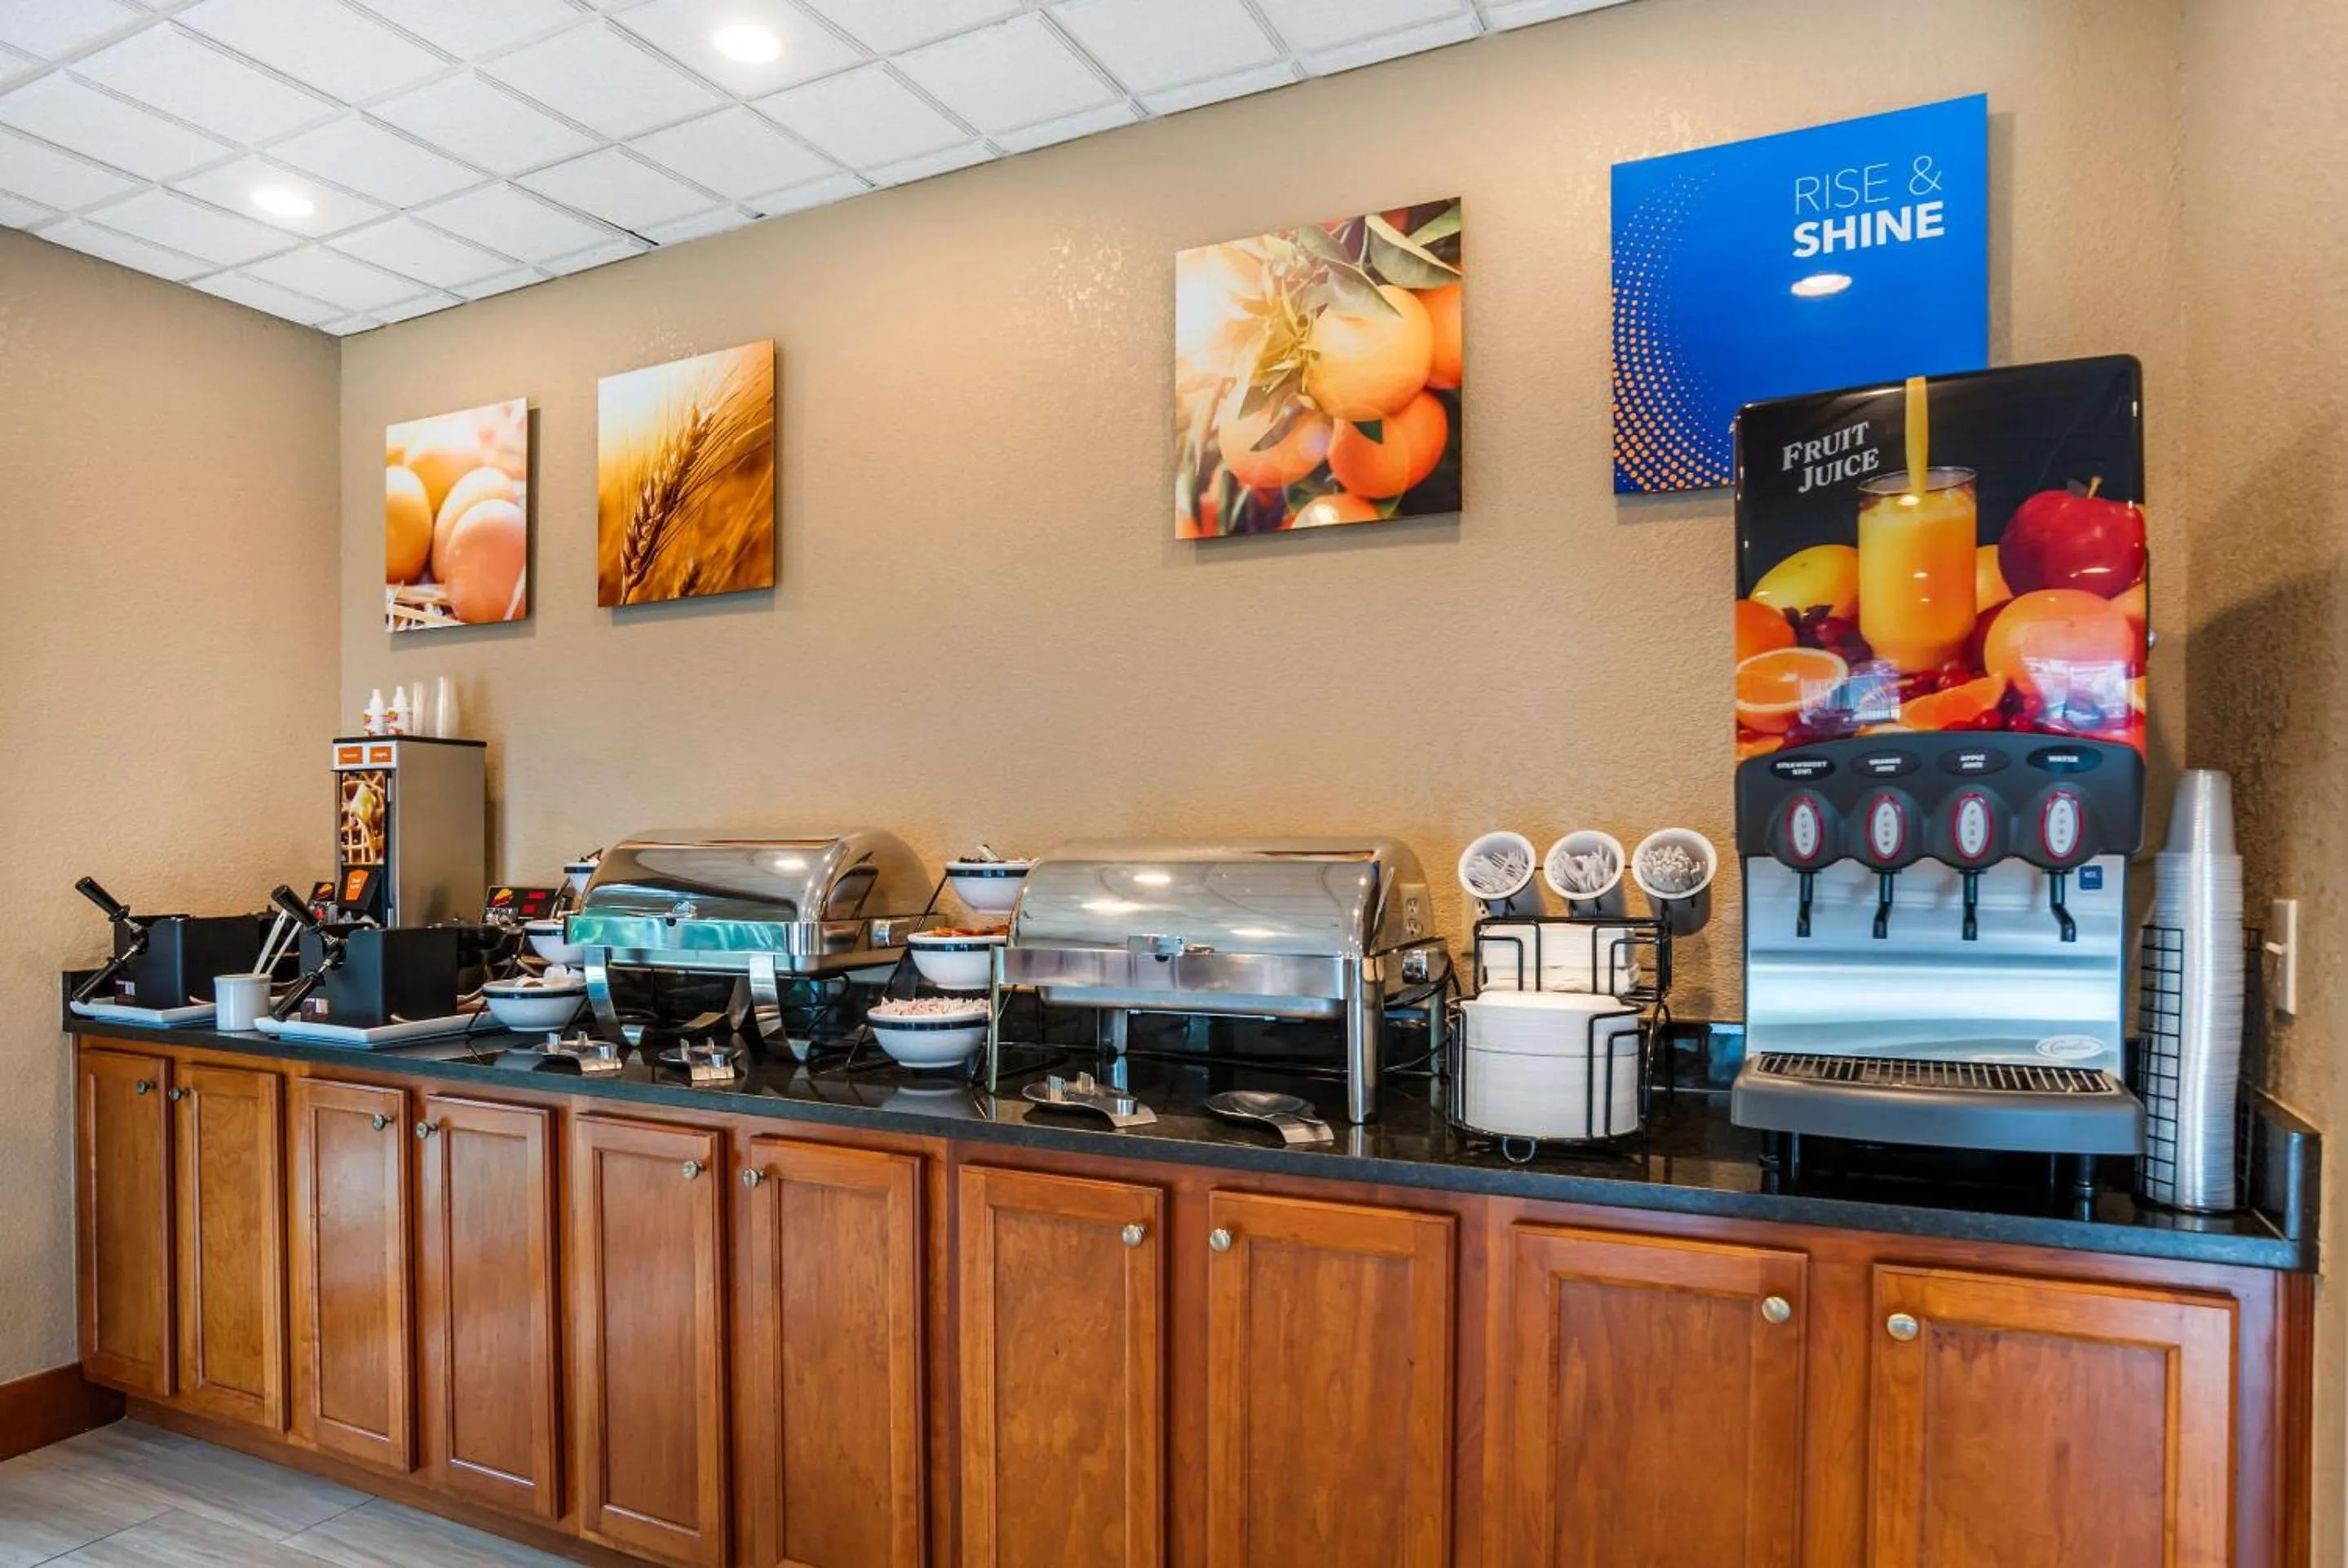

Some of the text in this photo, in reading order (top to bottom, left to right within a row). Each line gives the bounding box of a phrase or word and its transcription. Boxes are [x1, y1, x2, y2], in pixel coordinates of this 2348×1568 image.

[1794, 155, 1943, 215] RISE &
[1792, 200, 1945, 258] SHINE
[1782, 421, 1870, 471] FRUIT
[1797, 447, 1879, 493] JUICE
[1775, 760, 1828, 770] STRAWBERRY
[2048, 754, 2079, 763] WATER
